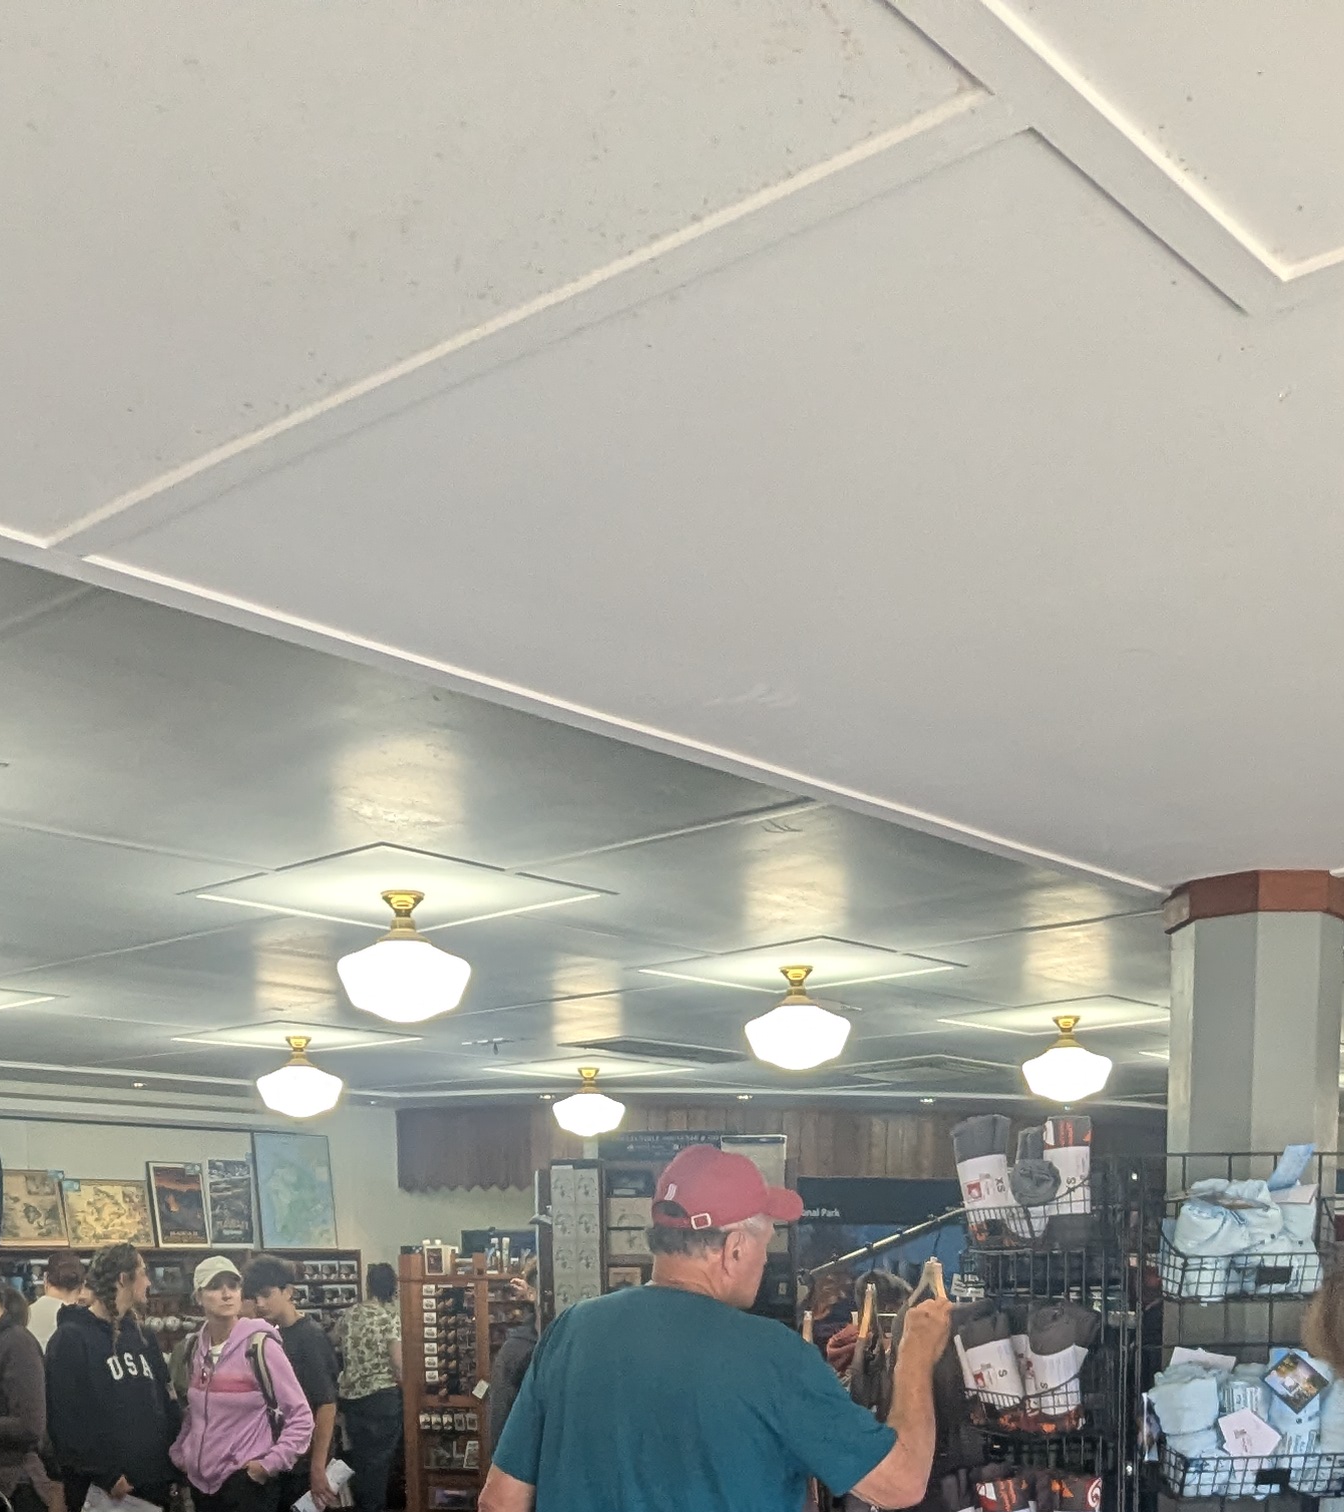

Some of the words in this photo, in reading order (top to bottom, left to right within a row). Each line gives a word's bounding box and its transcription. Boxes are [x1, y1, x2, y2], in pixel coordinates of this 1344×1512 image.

[994, 1176, 1006, 1193] XS
[820, 1208, 841, 1217] Park
[106, 1351, 155, 1381] USA
